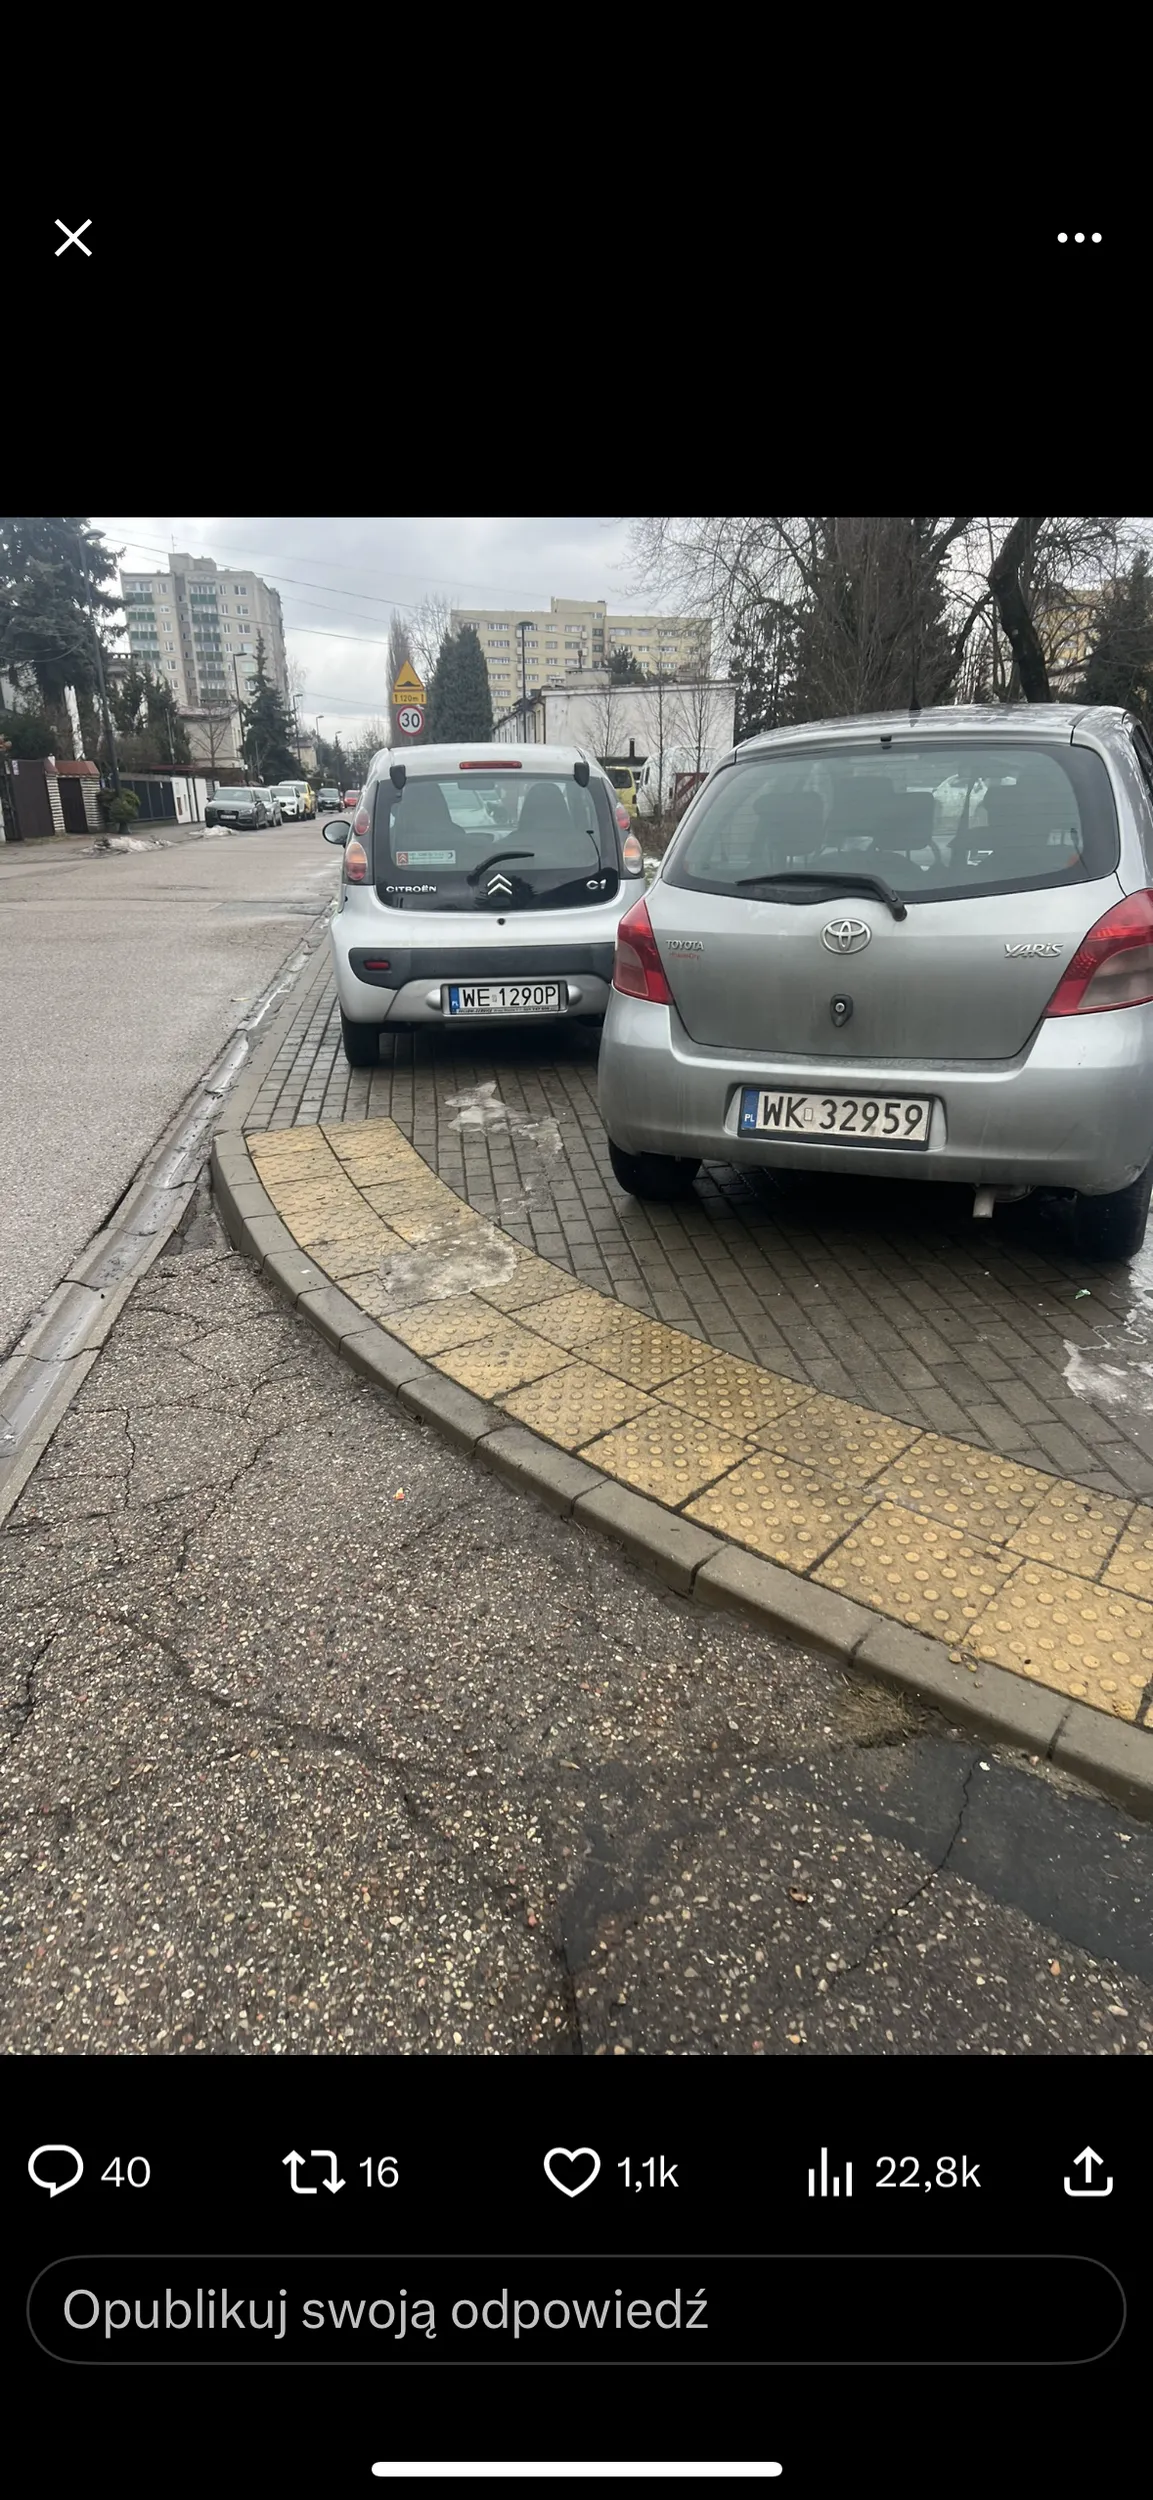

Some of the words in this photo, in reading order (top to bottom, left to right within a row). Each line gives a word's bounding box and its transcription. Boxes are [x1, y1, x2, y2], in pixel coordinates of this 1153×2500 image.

[401, 712, 421, 728] 30
[386, 884, 437, 893] CITROËN
[586, 878, 607, 890] C1
[665, 940, 705, 951] TOYOTA
[462, 988, 491, 1007] WE
[499, 986, 556, 1006] 1290P
[744, 1113, 755, 1122] PL
[763, 1095, 808, 1128] WK
[819, 1098, 923, 1136] 32959
